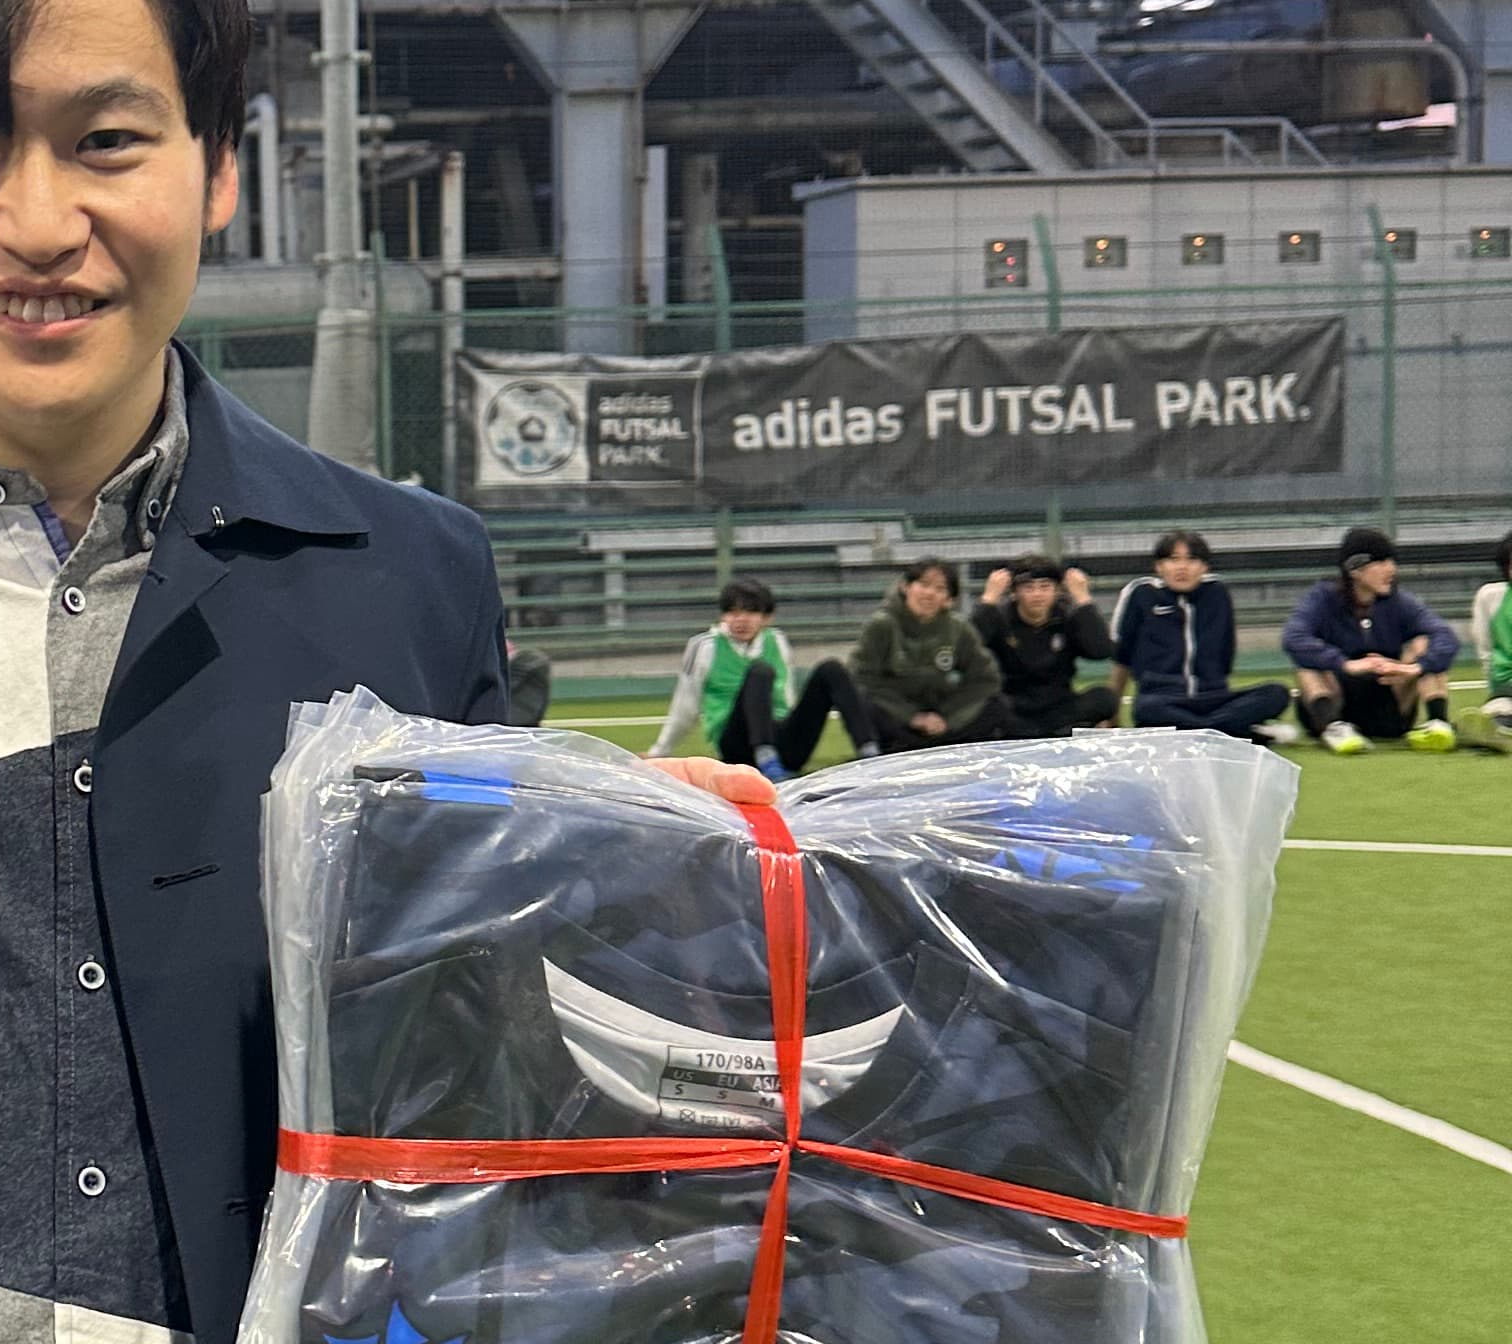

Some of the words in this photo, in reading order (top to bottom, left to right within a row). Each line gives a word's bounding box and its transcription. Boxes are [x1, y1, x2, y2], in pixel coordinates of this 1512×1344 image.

[597, 392, 674, 415] adidas
[733, 396, 905, 451] adidas
[925, 382, 1136, 440] FUTSAL
[1155, 372, 1312, 431] PARK.
[598, 417, 689, 442] FUTSAL
[695, 1052, 766, 1071] 170/98A
[673, 1069, 694, 1082] US
[717, 1074, 738, 1089] EU
[674, 1083, 685, 1096] S
[717, 1090, 728, 1100] S
[759, 1097, 776, 1108] M
